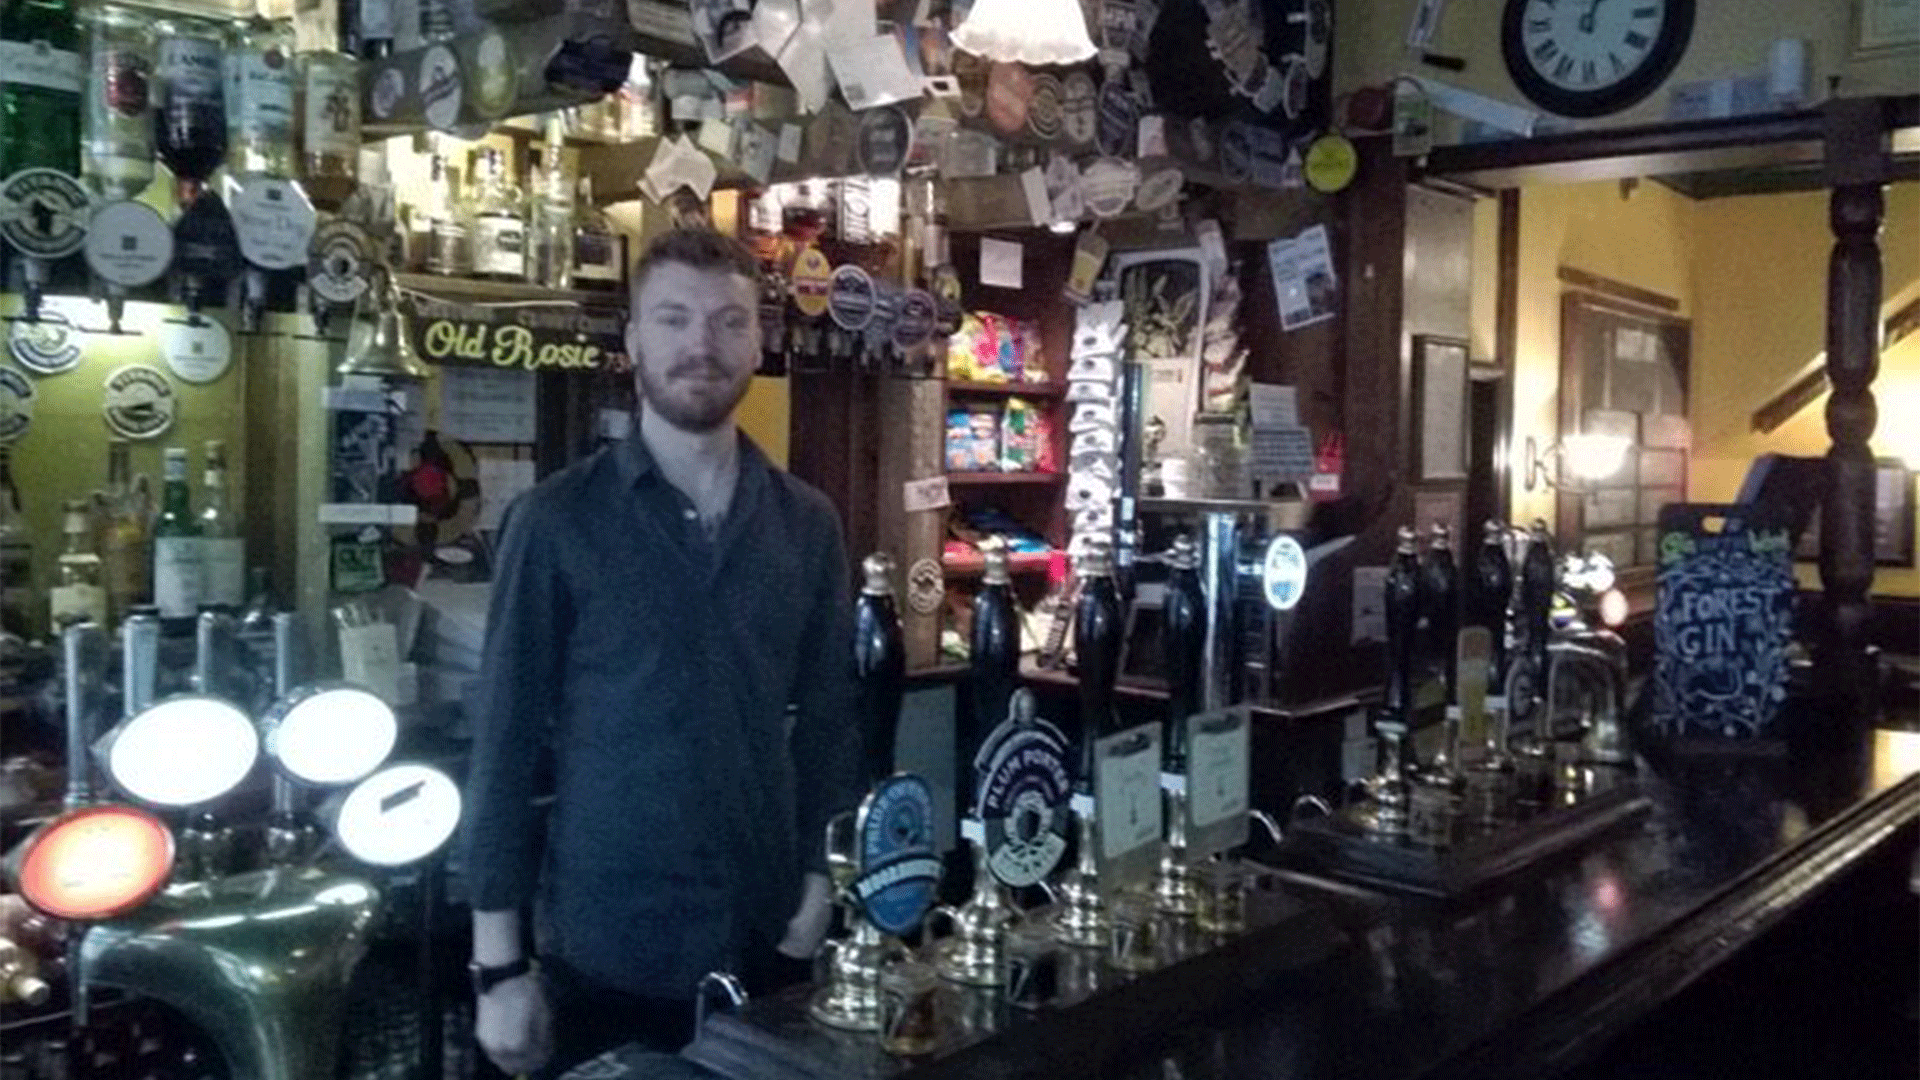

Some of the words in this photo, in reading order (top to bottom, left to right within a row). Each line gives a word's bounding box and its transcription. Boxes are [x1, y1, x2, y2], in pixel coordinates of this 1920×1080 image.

[424, 319, 486, 359] Old
[490, 324, 600, 371] Rosie
[1681, 585, 1782, 623] FOREST
[1678, 623, 1737, 658] GIN
[986, 755, 1022, 809] PLUM
